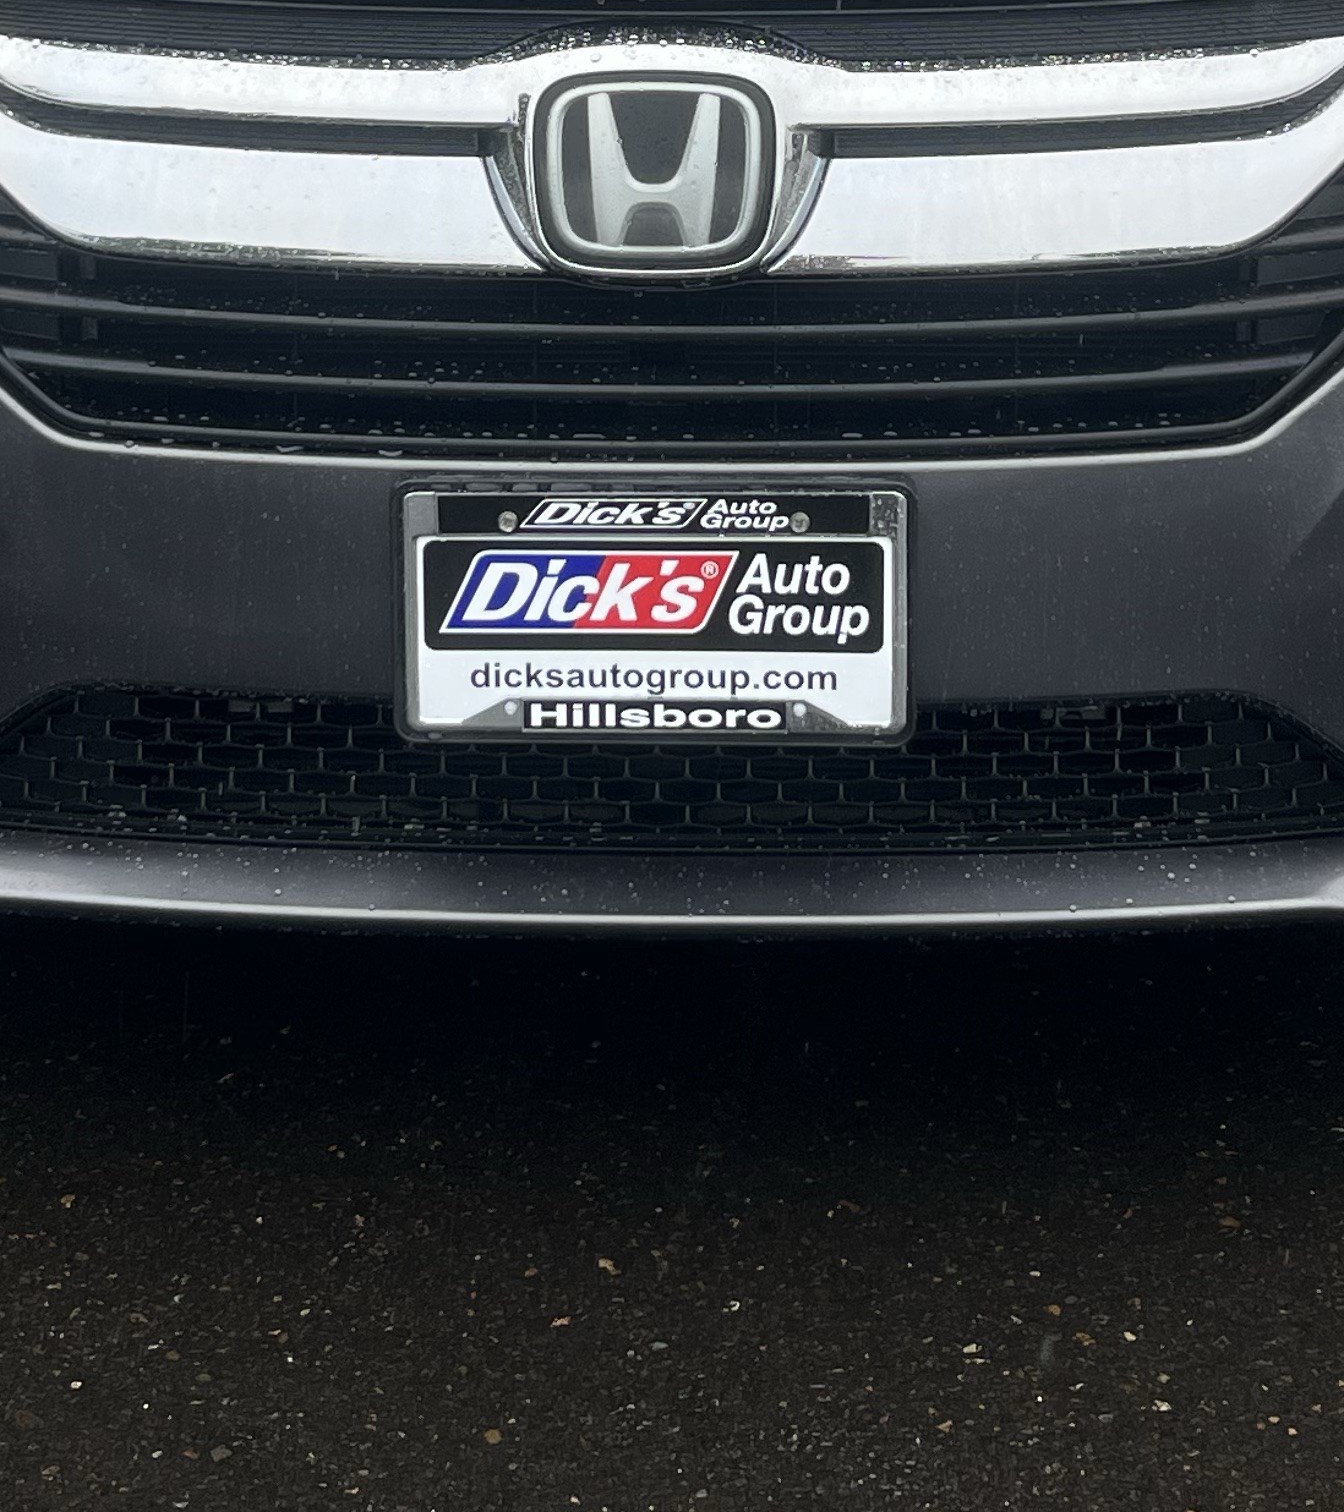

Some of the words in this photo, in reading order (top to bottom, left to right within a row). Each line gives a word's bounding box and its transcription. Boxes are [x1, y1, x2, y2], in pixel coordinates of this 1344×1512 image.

[534, 501, 687, 525] Dick's
[708, 498, 777, 515] Auto
[700, 514, 789, 531] Group
[462, 559, 704, 622] Dick's
[736, 553, 851, 595] Auto
[728, 595, 870, 644] Group
[470, 662, 838, 695] dicksautogroup.com
[529, 703, 781, 728] Hillsboro
